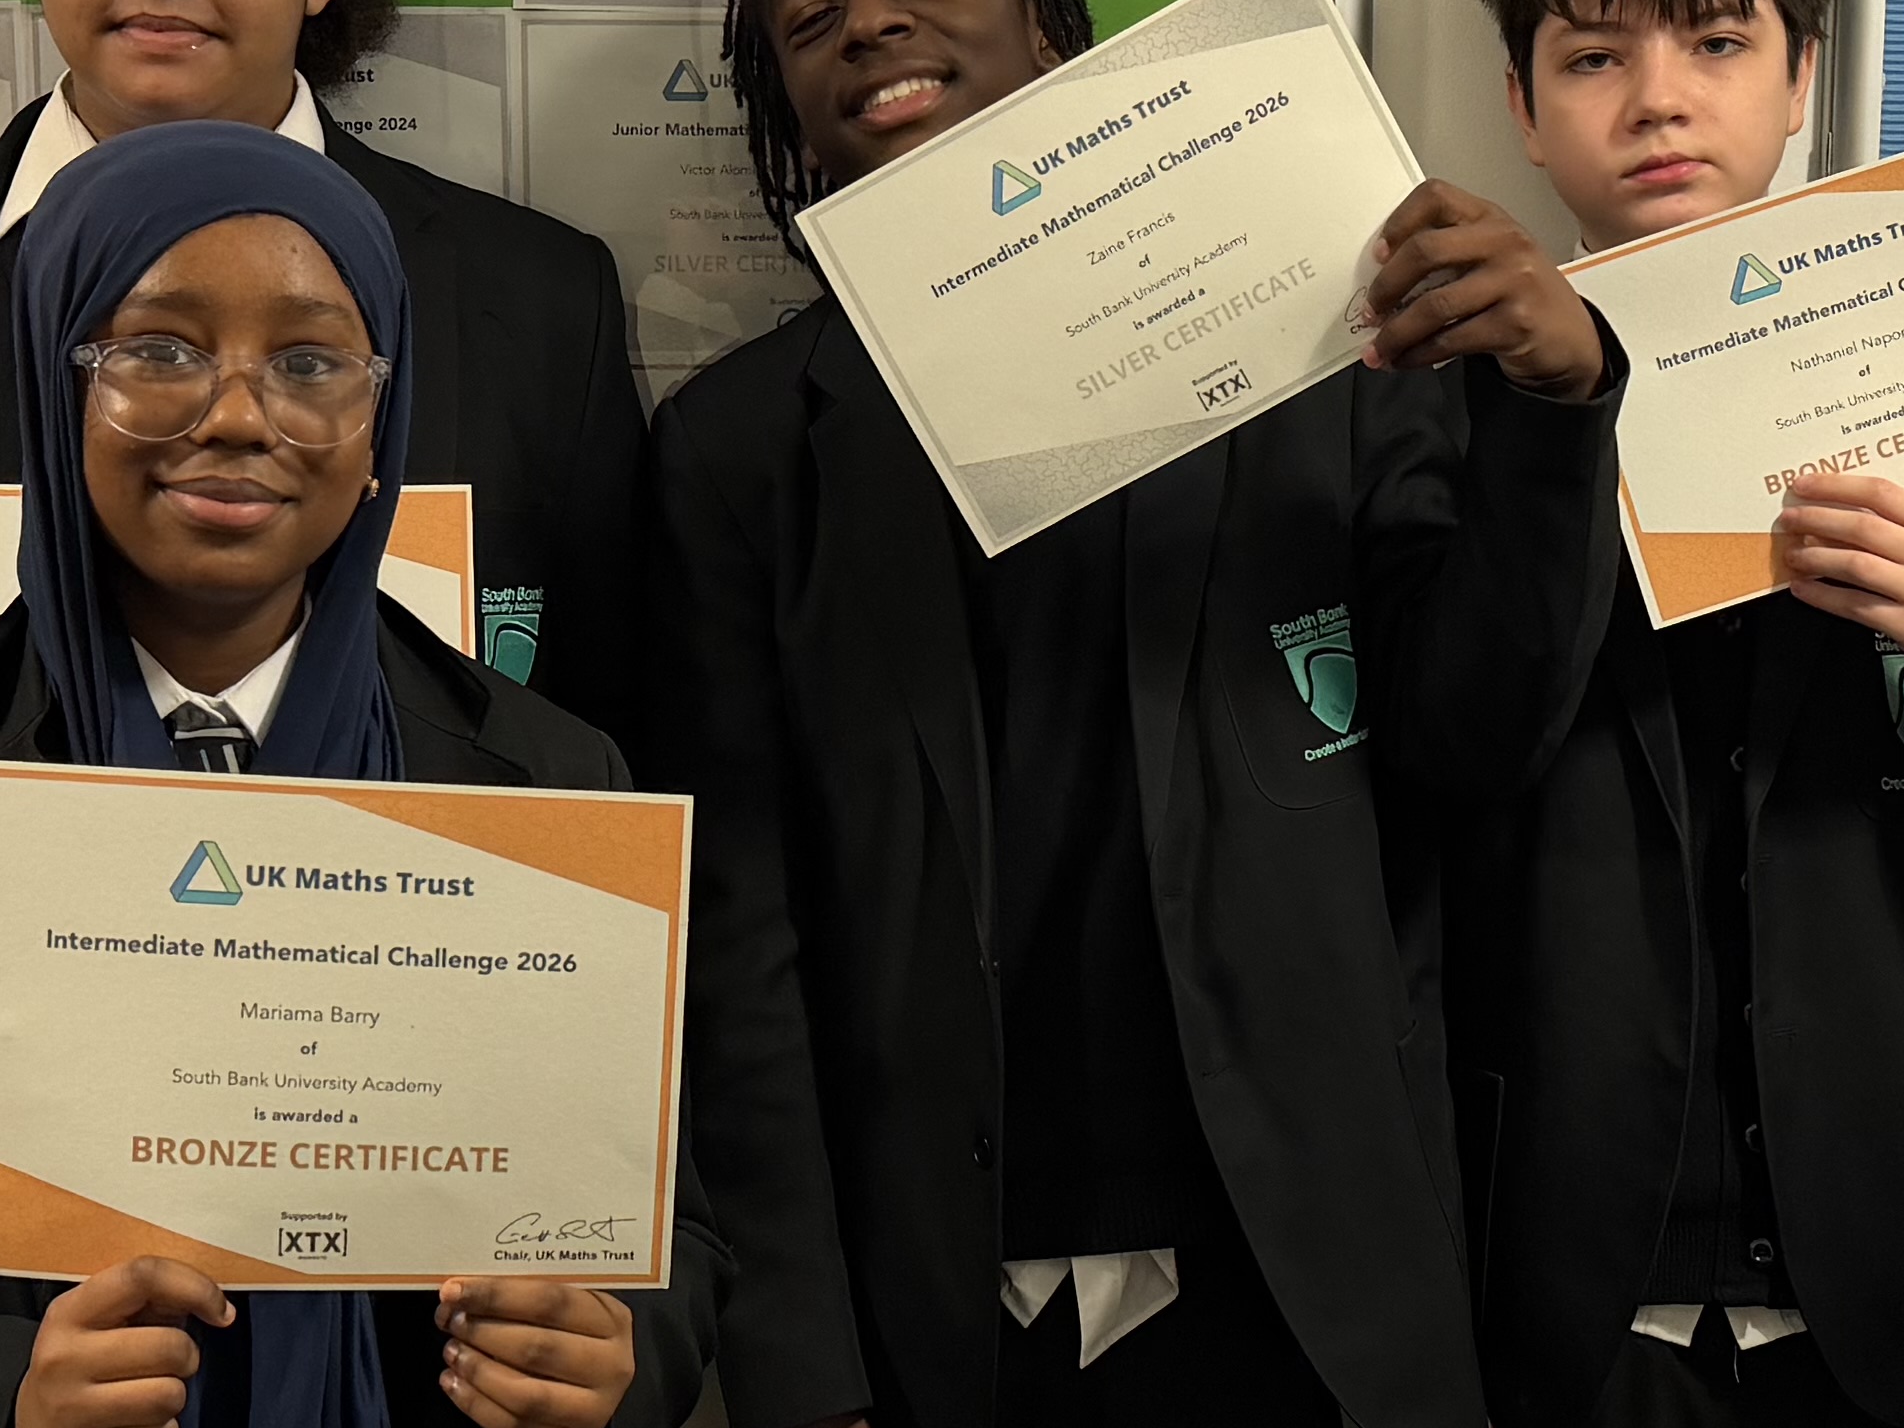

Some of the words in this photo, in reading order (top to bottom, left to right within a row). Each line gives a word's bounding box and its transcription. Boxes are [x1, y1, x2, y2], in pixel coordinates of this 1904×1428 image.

[931, 234, 1039, 298] Intermediate
[1041, 164, 1156, 237] Mathematical
[1158, 121, 1242, 171] Challenge
[1245, 92, 1289, 124] 2026
[1087, 241, 1125, 265] Zaine
[1127, 213, 1175, 243] Francis
[1076, 344, 1161, 400] SILVER
[1163, 258, 1316, 351] CERTIFICATE
[1791, 341, 1858, 372] Nathaniel
[1764, 445, 1870, 495] BRONZE
[246, 865, 286, 887] UK
[296, 868, 387, 892] Maths
[396, 872, 474, 896] Trust
[47, 929, 204, 956] Intermediate
[214, 939, 379, 965] Mathematical
[388, 946, 508, 975] Challenge
[517, 952, 577, 972] 2026
[241, 1002, 323, 1022] Mariama
[331, 1006, 380, 1029] Barry
[132, 1136, 277, 1168] BRONZE
[290, 1143, 509, 1173] CERTIFICATE
